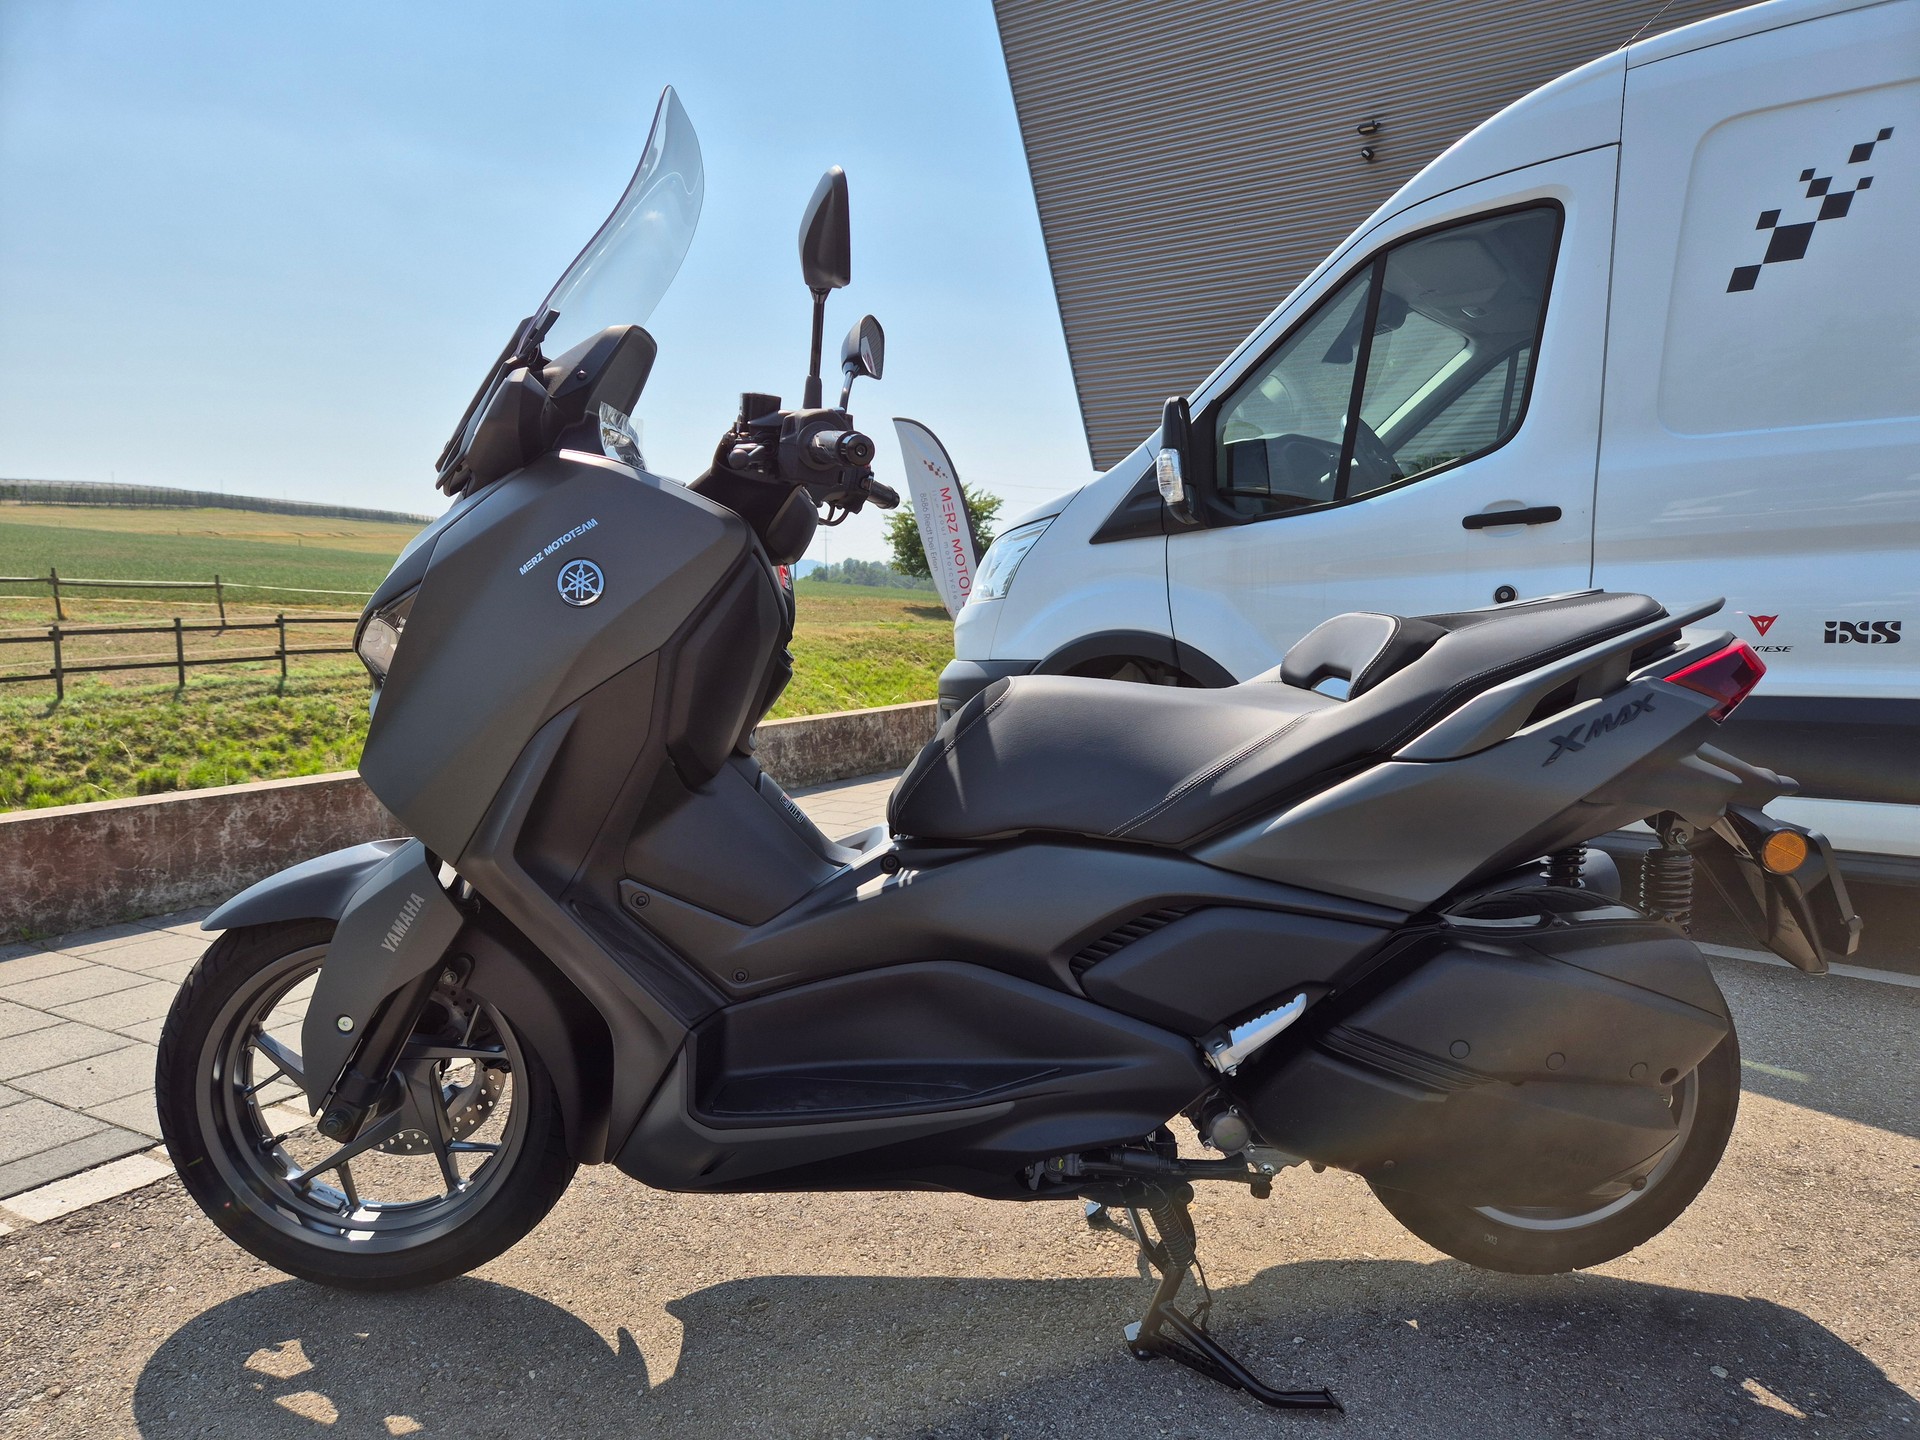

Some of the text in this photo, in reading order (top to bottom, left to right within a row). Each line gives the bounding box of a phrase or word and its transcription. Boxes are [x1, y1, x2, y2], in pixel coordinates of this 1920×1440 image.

[920, 493, 929, 512] 8586
[519, 518, 598, 575] MERZ MOTOTEAM
[940, 487, 972, 607] MERZ MOTOT
[381, 892, 425, 953] YAMAHA
